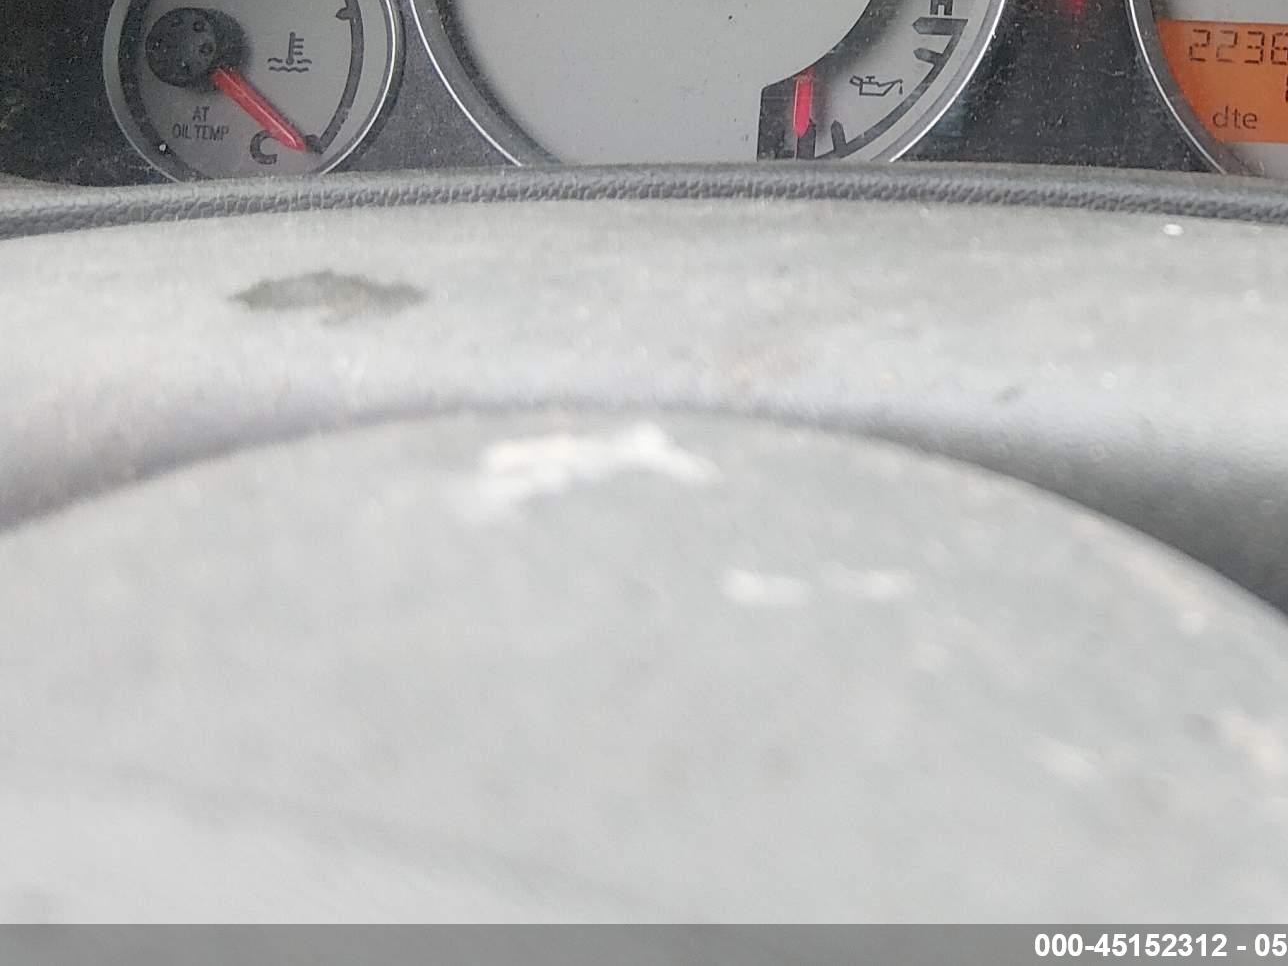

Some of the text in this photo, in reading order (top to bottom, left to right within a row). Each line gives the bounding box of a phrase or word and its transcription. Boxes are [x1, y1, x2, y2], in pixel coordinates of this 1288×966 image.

[1212, 106, 1258, 130] dte
[172, 123, 230, 141] OIL TEMP
